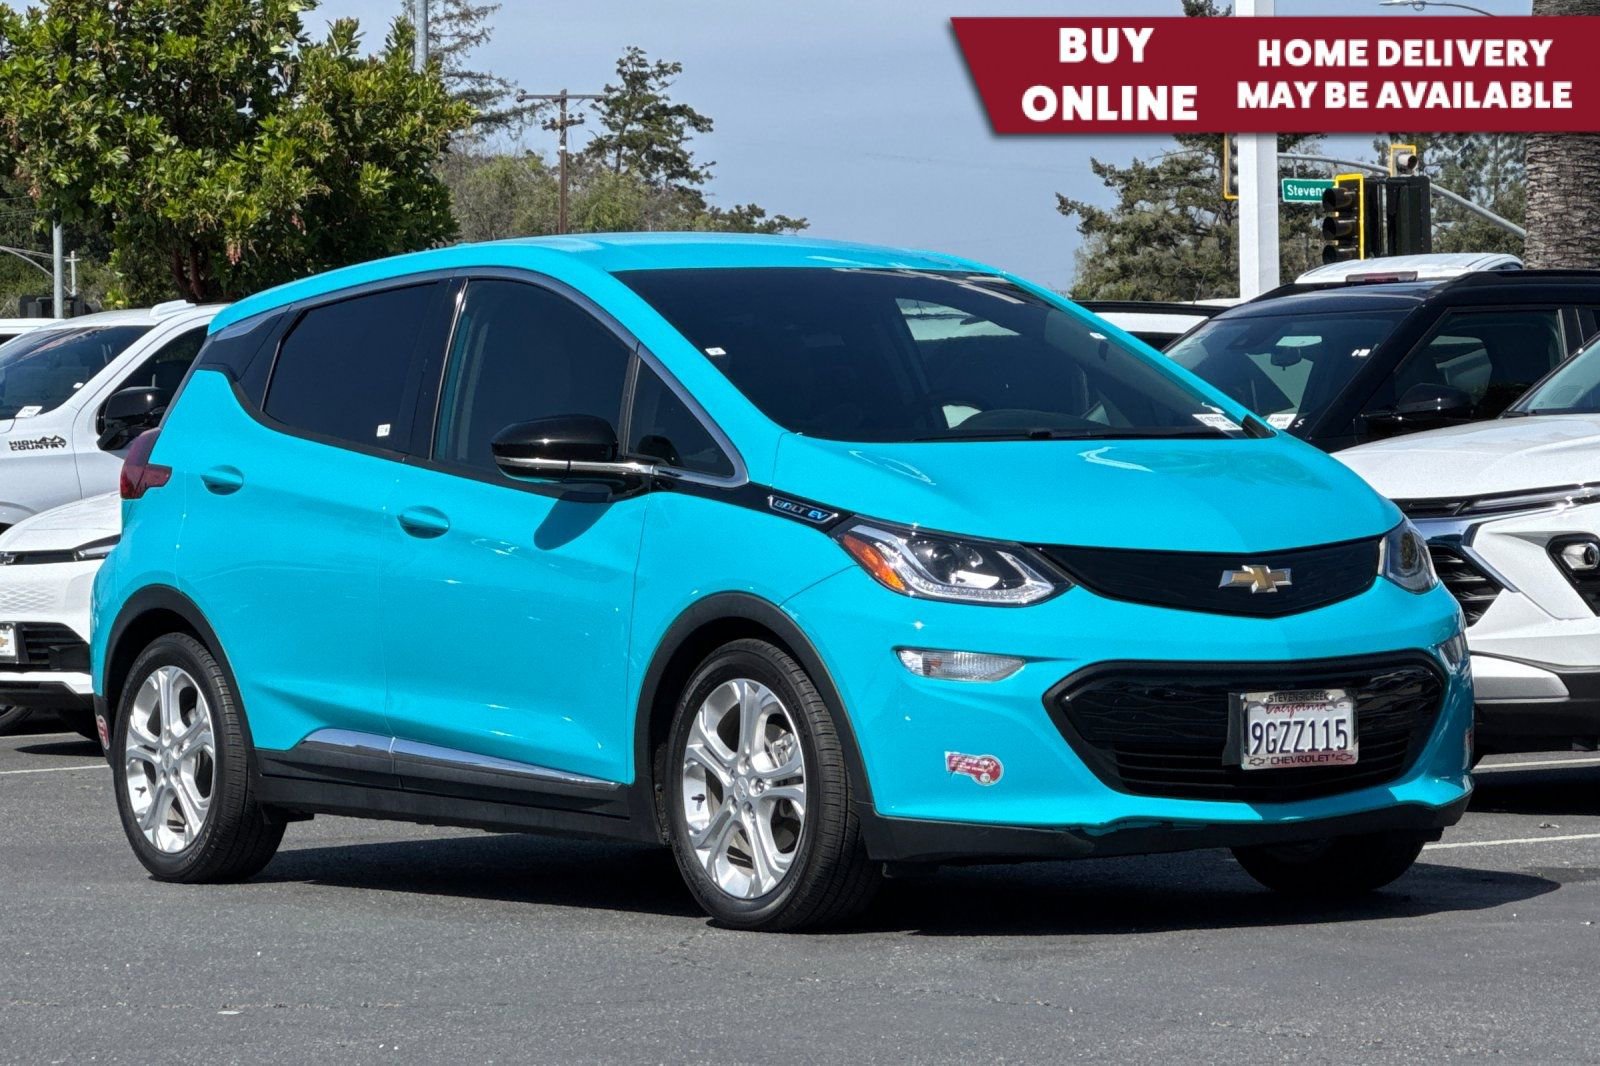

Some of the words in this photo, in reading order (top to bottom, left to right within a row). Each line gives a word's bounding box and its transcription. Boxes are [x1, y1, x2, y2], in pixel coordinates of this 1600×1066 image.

[807, 509, 828, 519] EV
[1251, 718, 1348, 755] 9GZZ115
[1270, 754, 1331, 765] CHEVROLET
